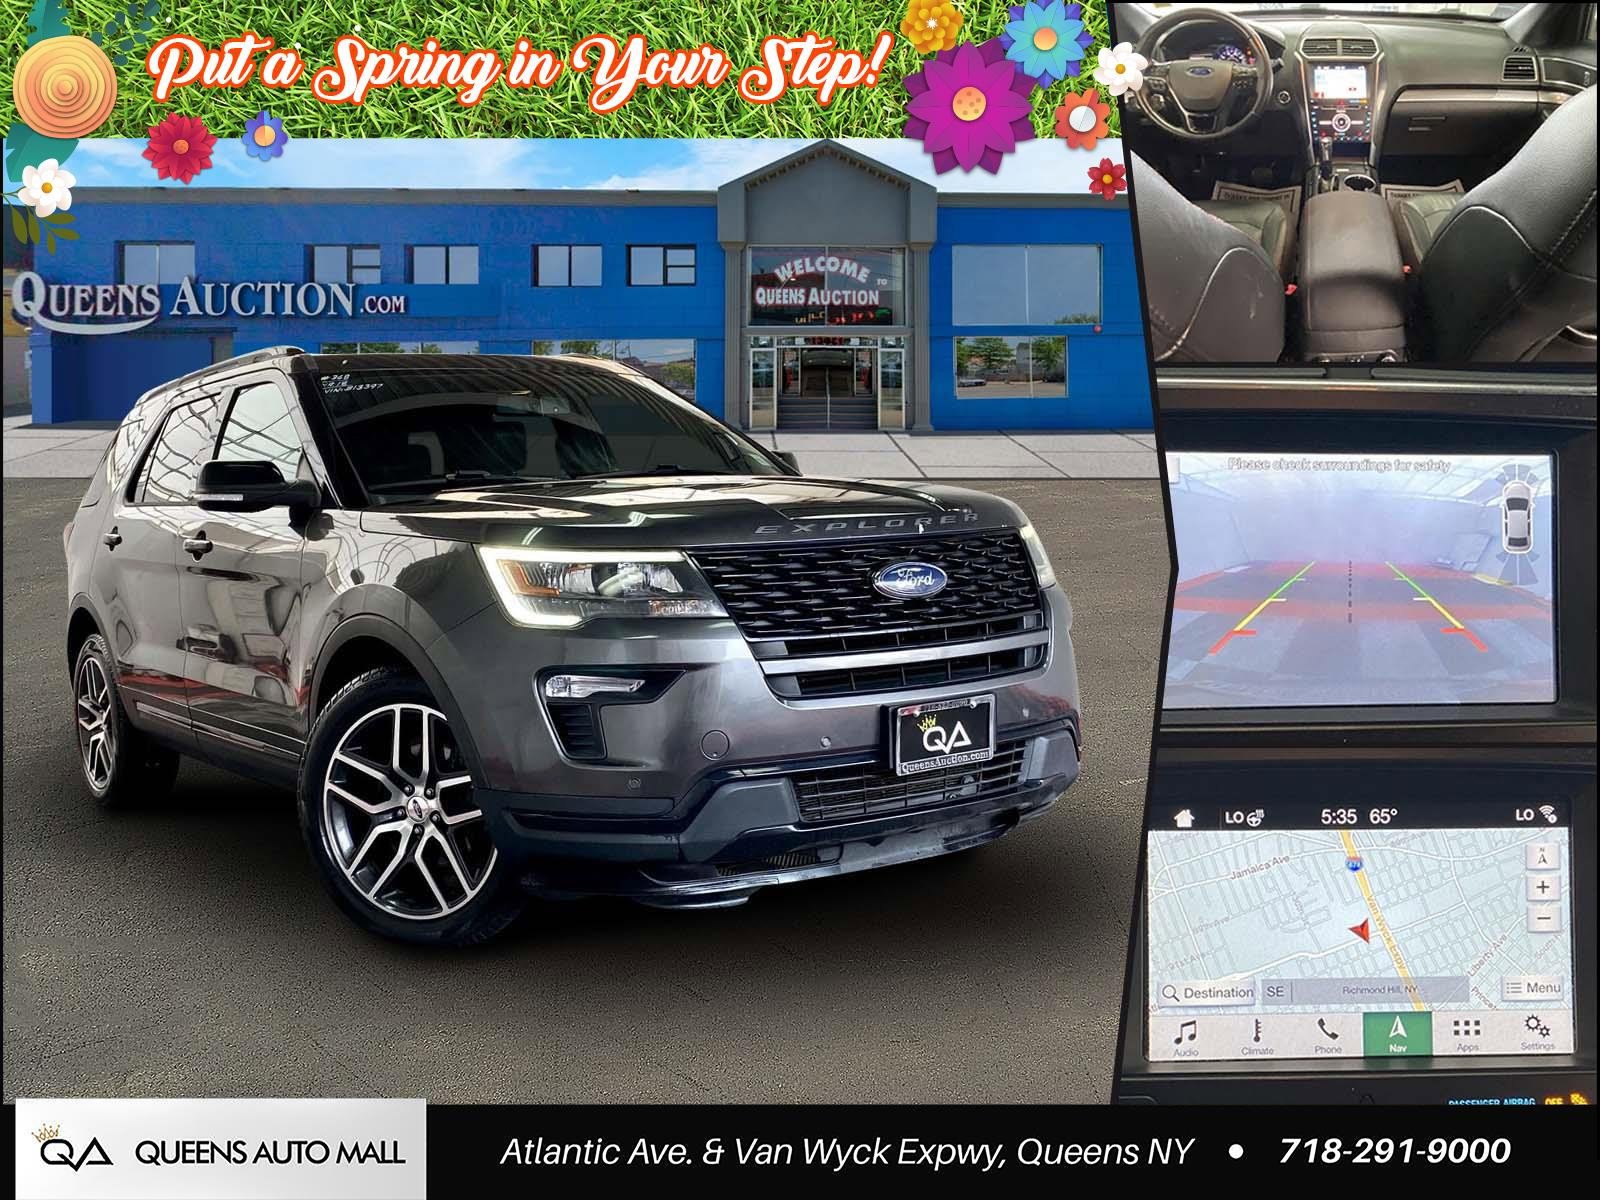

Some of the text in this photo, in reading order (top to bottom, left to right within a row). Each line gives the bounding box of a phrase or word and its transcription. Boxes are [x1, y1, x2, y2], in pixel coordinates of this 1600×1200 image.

[774, 256, 871, 284] WELCOME
[12, 271, 160, 335] QUEENS
[755, 287, 880, 305] QUEENS AUCTION
[1228, 457, 1452, 473] Please check surroundings for safety
[755, 512, 979, 534] EXPLORER
[892, 567, 936, 591] Ford
[902, 749, 991, 774] QueensAuction.com
[1225, 810, 1244, 825] LO
[1321, 808, 1398, 825] 5:35 65°
[1515, 807, 1535, 822] LO
[1230, 855, 1290, 880] Jamaica Ave
[1467, 934, 1508, 977] Liberty Ave
[1184, 986, 1254, 999] Destination
[1266, 985, 1285, 998] SE
[1342, 985, 1386, 995] Richmond
[1405, 985, 1418, 994] NY
[1526, 982, 1561, 994] Menu
[1174, 1048, 1199, 1057] Audio
[1241, 1047, 1274, 1056] Climate
[1315, 1045, 1342, 1055] Phone
[1389, 1043, 1407, 1053] Nav
[1457, 1043, 1479, 1053] Apps
[1520, 1041, 1556, 1052] Settings
